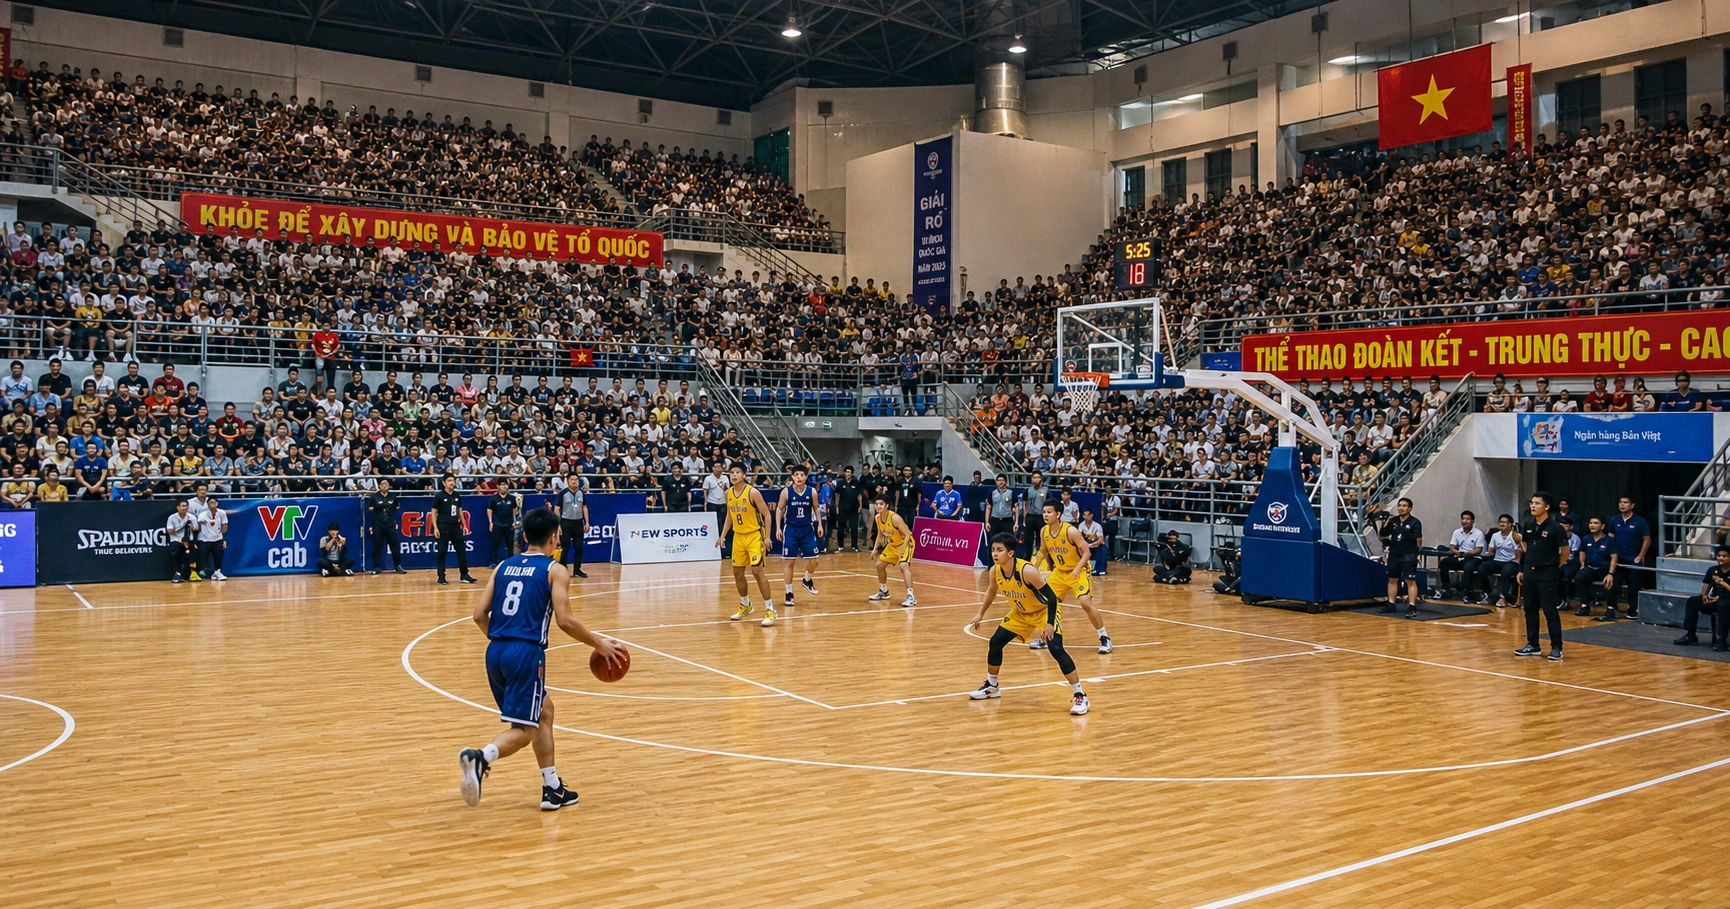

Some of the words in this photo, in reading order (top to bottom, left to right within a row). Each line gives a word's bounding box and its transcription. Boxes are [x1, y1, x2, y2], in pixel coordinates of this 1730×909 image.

[200, 201, 269, 231] KHỎE
[278, 205, 312, 233] ĐỂ
[319, 212, 365, 236] XÂY
[446, 221, 475, 246] VÀ
[483, 223, 526, 249] BẢO
[533, 229, 559, 256] VỆ
[565, 228, 591, 254] TỔ
[597, 234, 650, 259] QUỐC
[1126, 241, 1151, 260] 5:25
[1129, 262, 1145, 285] 18
[1254, 336, 1289, 371] THỂ
[1295, 343, 1347, 370] THAO
[1353, 335, 1413, 369] ĐOÀN
[1420, 329, 1463, 367] KẾT
[1485, 333, 1569, 365] TRUNG
[1578, 326, 1650, 369] THỰC
[663, 526, 709, 538] SPORTS
[267, 541, 307, 569] cab
[501, 580, 524, 616] 8
